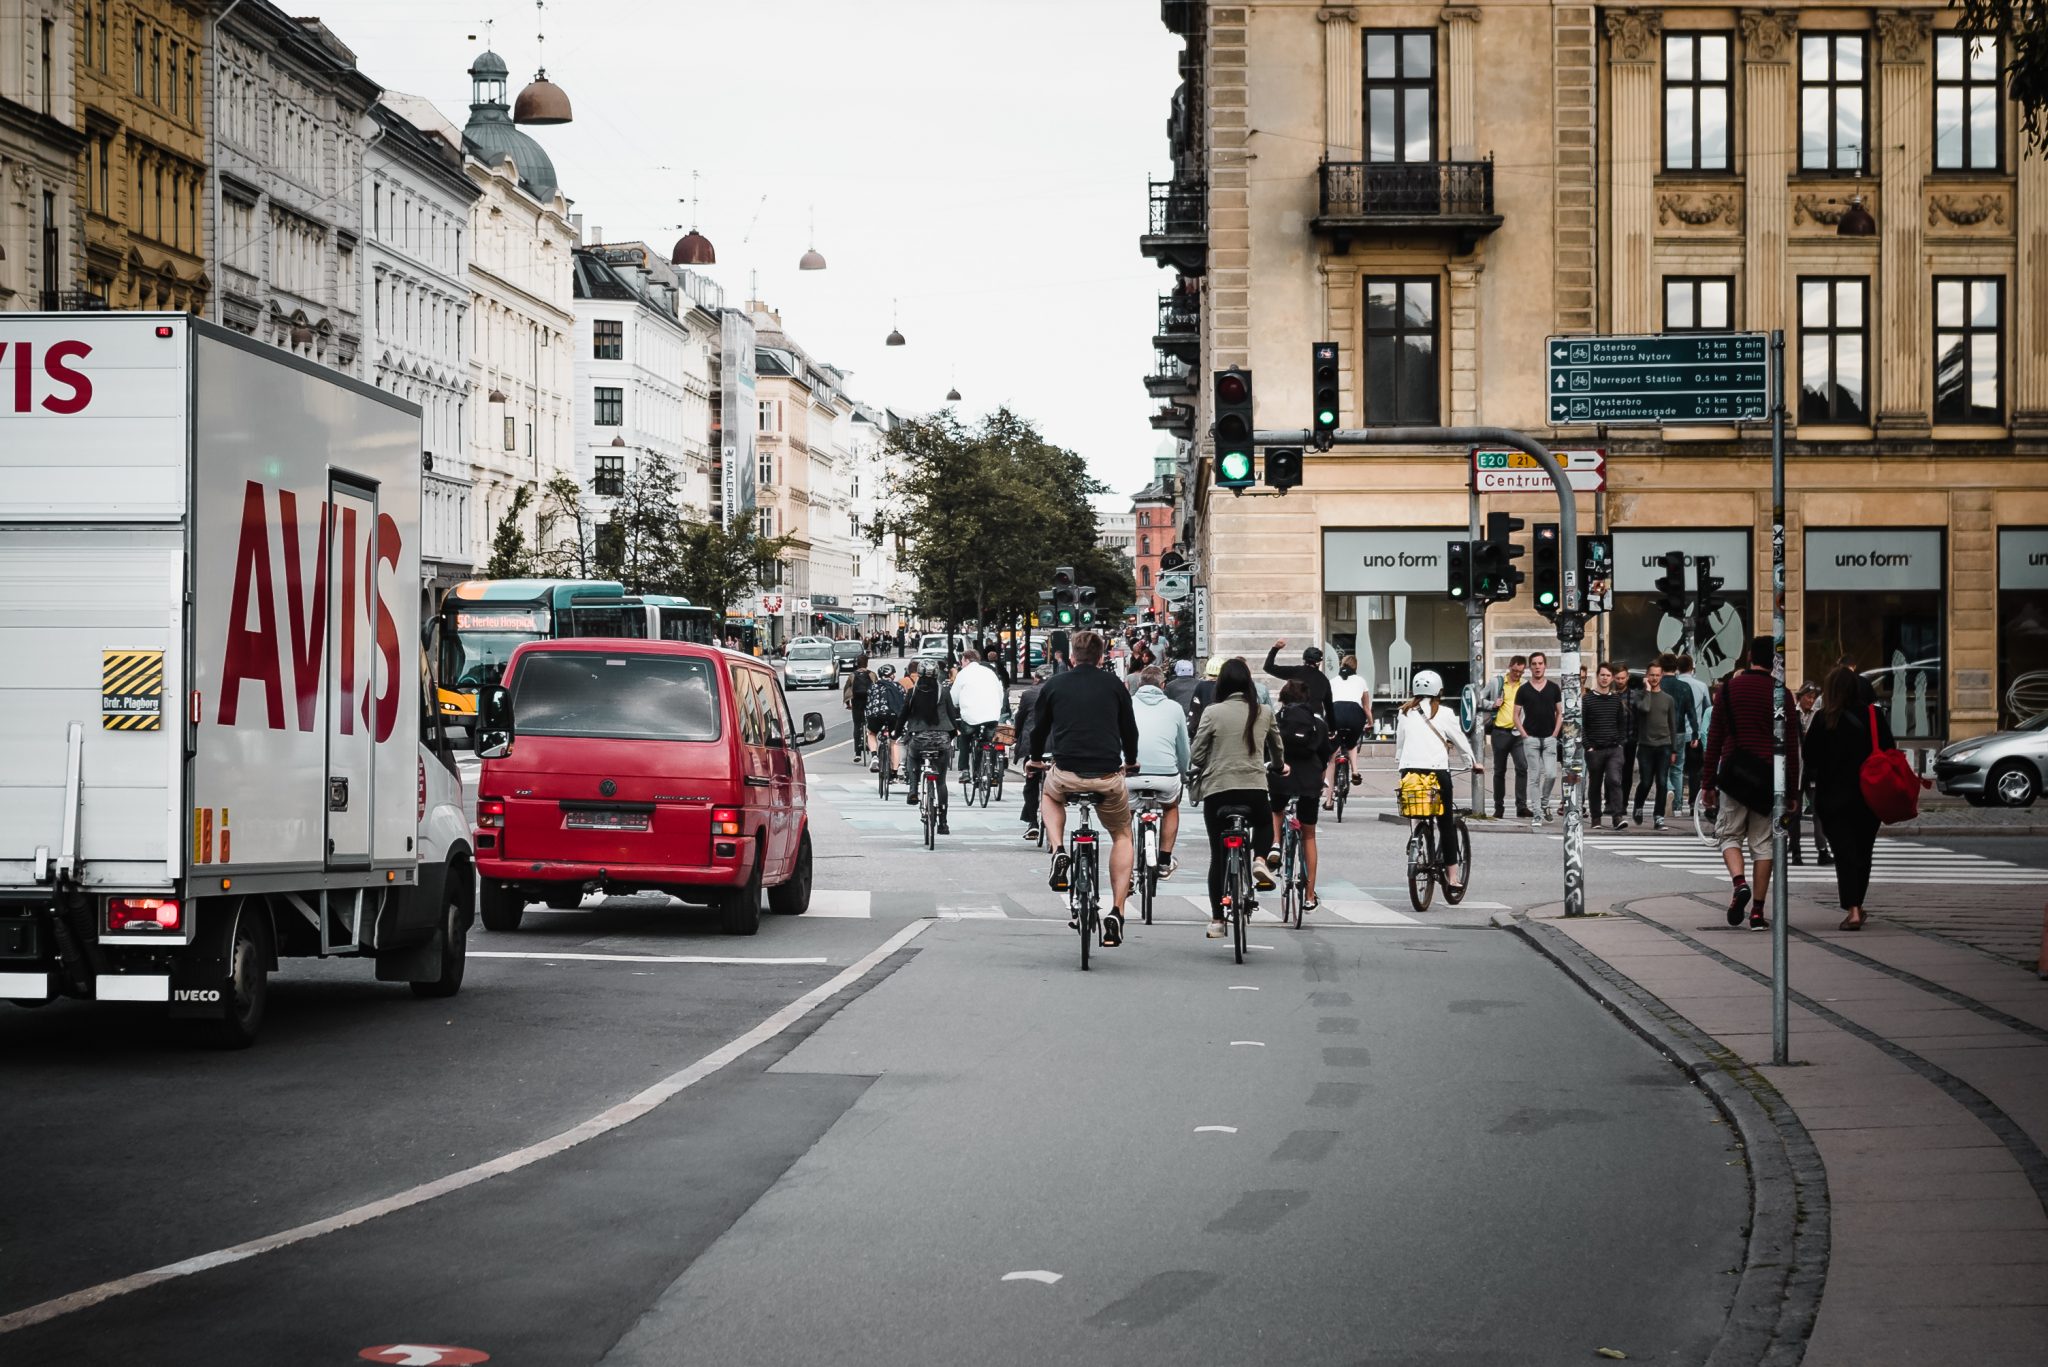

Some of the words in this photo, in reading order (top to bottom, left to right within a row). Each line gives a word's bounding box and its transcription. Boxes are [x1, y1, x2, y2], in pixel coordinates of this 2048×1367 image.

[1593, 344, 1637, 352] Østerbro
[1714, 341, 1727, 349] km
[1735, 341, 1742, 349] 6
[1593, 354, 1634, 362] Kongens
[1638, 353, 1671, 361] Nytorv
[1714, 351, 1727, 359] km
[1736, 351, 1742, 359] 5
[1593, 376, 1641, 384] Nørreport
[1645, 375, 1682, 383] Station
[1695, 374, 1710, 382] 0.5
[1714, 374, 1728, 382] km
[1736, 373, 1742, 381] 2
[1744, 373, 1762, 381] min
[1593, 398, 1642, 406] Vesterbro
[1714, 396, 1728, 404] km
[1735, 396, 1742, 404] 6
[1593, 408, 1677, 417] Gyldenløvesgade
[1714, 406, 1728, 414] km
[1736, 406, 1742, 414] 3
[1480, 456, 1504, 466] E20
[1517, 456, 1529, 465] 21
[1485, 474, 1553, 487] Centrum
[1364, 556, 1395, 567] uno
[1398, 552, 1437, 567] form
[1835, 555, 1867, 566] uno
[1869, 551, 1909, 566] form
[217, 479, 402, 743] AVIS
[501, 616, 534, 629] Hospital
[103, 697, 122, 708] Brdr.
[124, 697, 158, 710] Plagborg
[174, 990, 220, 1001] IVECO
